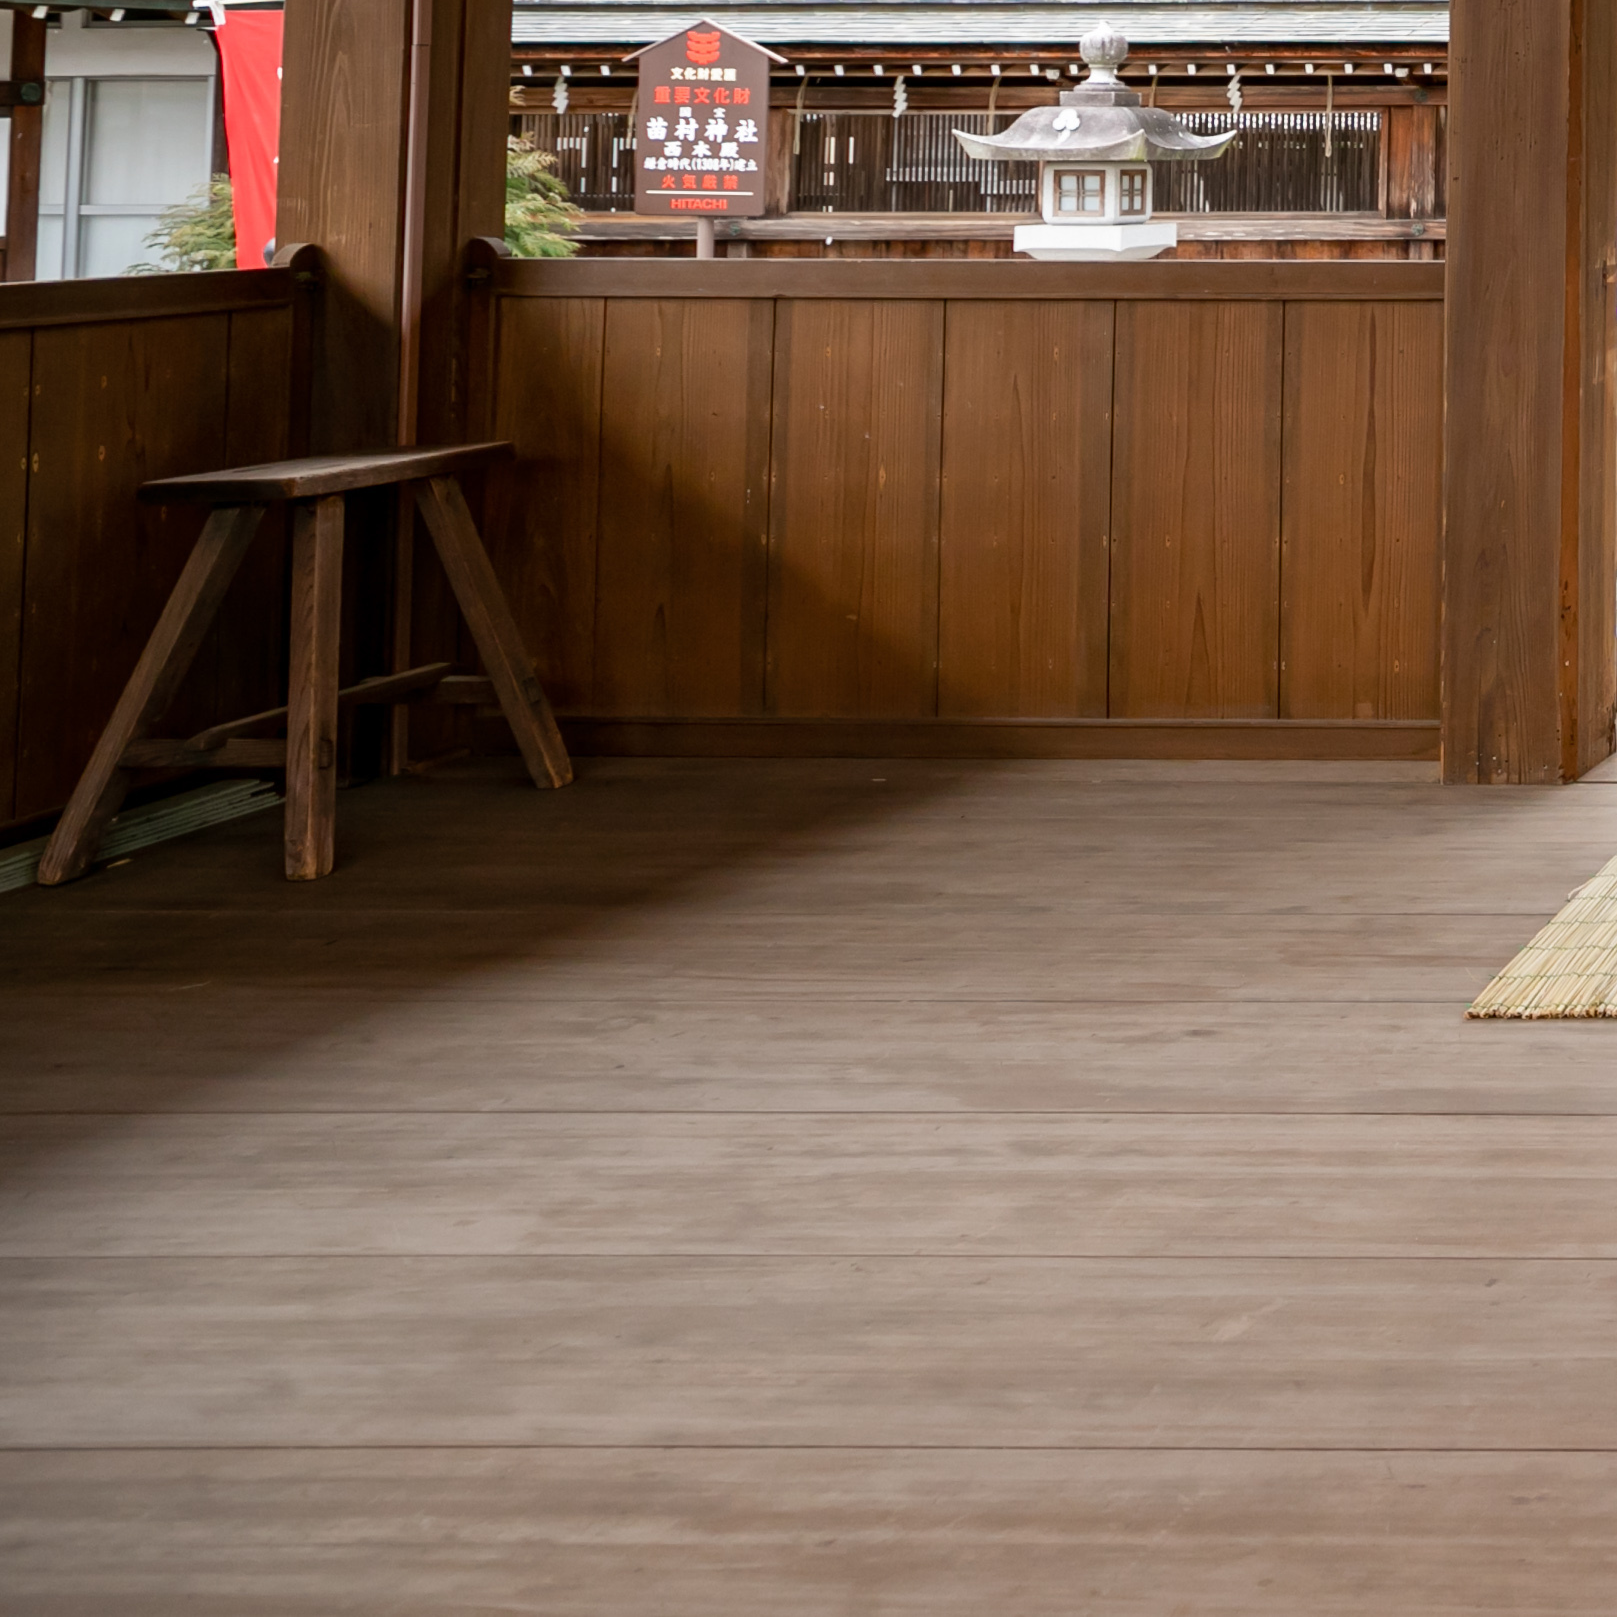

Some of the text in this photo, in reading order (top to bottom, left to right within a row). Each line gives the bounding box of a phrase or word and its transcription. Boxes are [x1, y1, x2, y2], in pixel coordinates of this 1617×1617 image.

[654, 86, 750, 104] 重要文化財
[646, 116, 759, 142] 苗村神社
[663, 141, 740, 158] 西本殿
[661, 174, 739, 189] 火気厳禁
[670, 198, 728, 210] HITACHI
